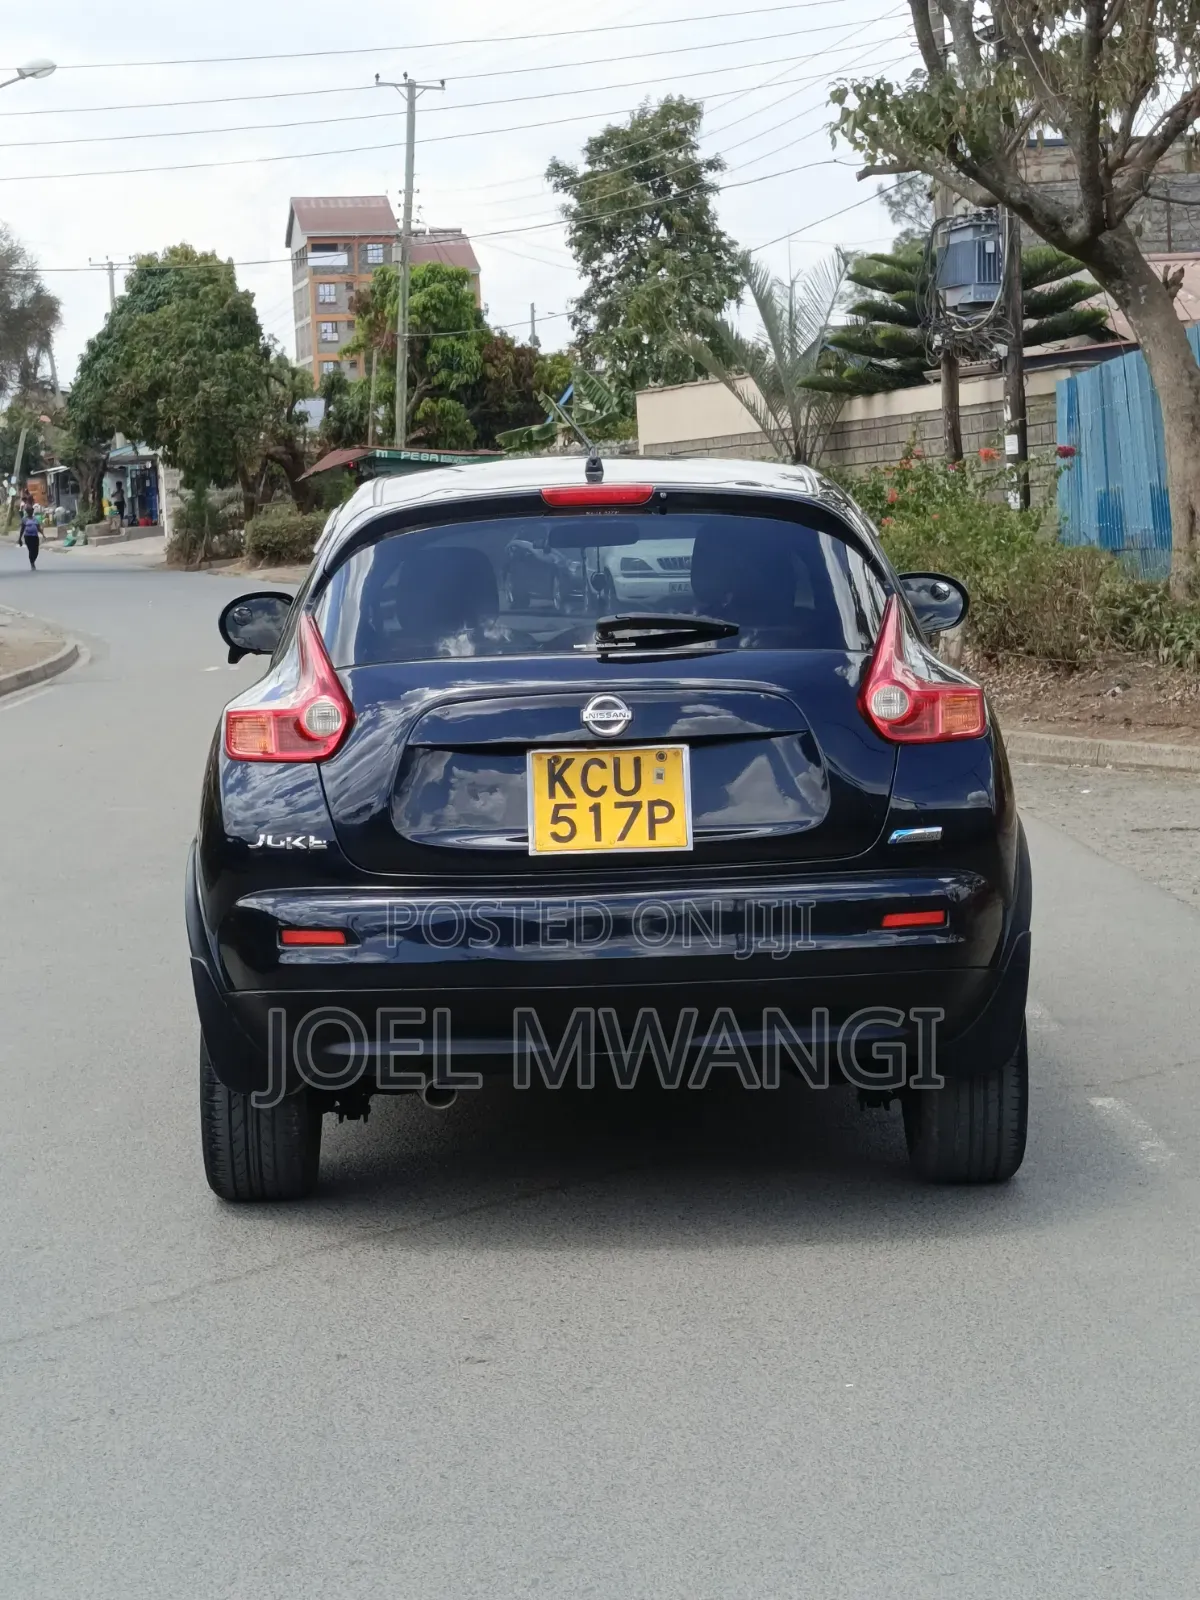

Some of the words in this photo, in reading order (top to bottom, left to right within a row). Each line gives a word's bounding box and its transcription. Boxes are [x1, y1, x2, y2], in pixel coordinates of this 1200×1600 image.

[547, 756, 642, 800] KCU
[247, 834, 328, 850] JUKE
[549, 799, 675, 844] 517P
